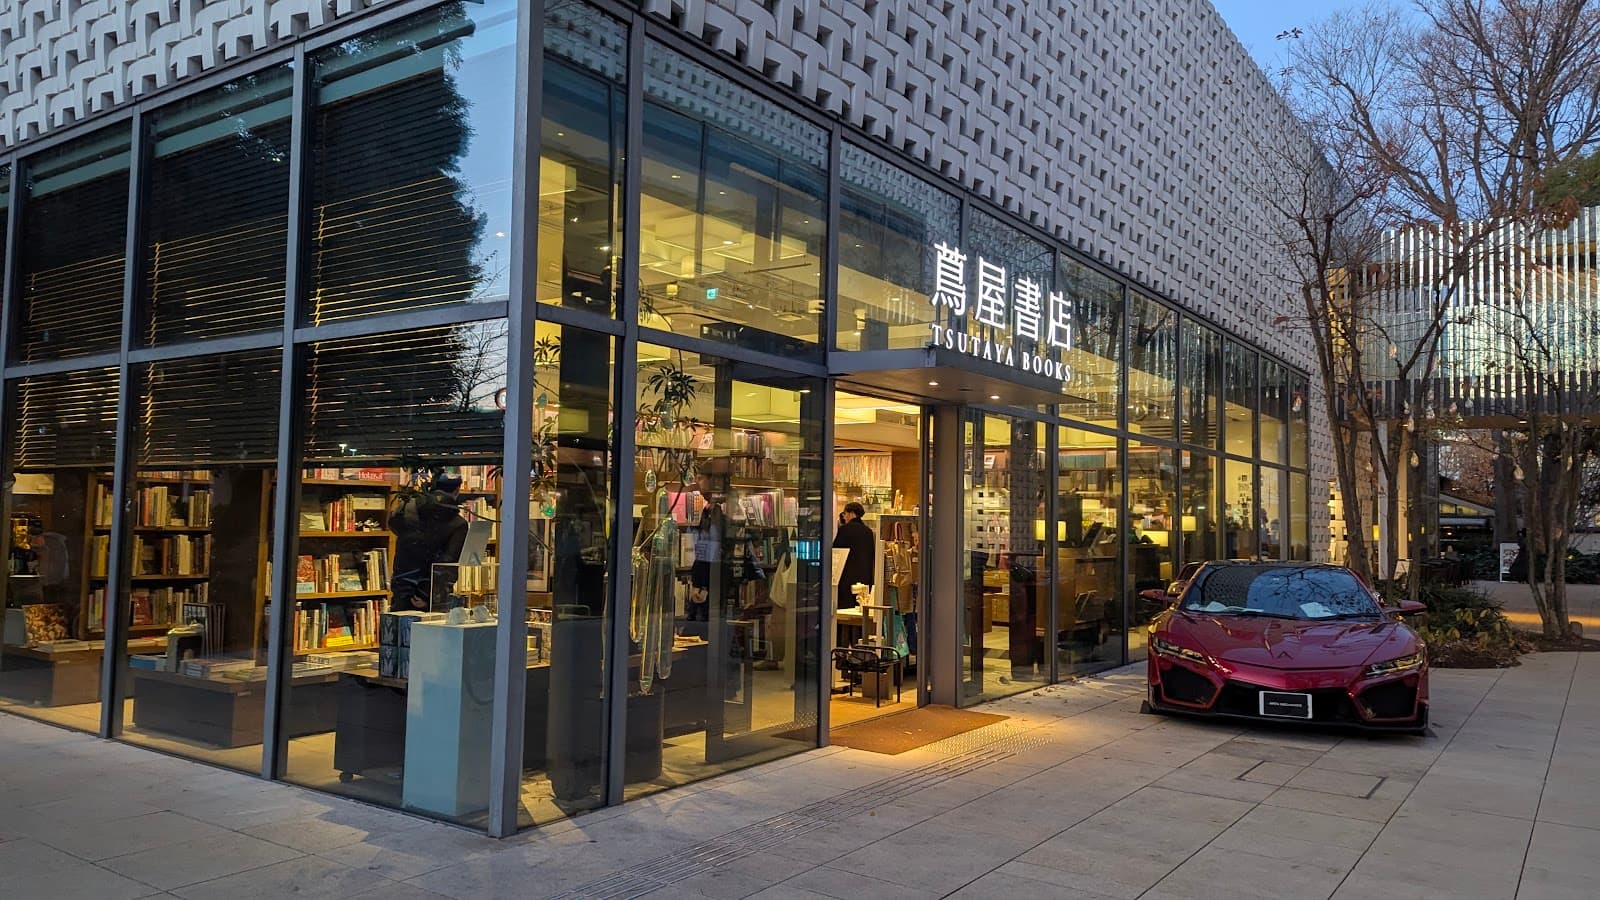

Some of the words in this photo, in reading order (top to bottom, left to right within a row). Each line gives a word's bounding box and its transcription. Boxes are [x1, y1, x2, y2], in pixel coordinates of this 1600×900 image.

[930, 240, 1072, 352] 蔦屋書店
[931, 323, 1014, 367] TSUTAYA
[1022, 351, 1071, 382] BOOKS
